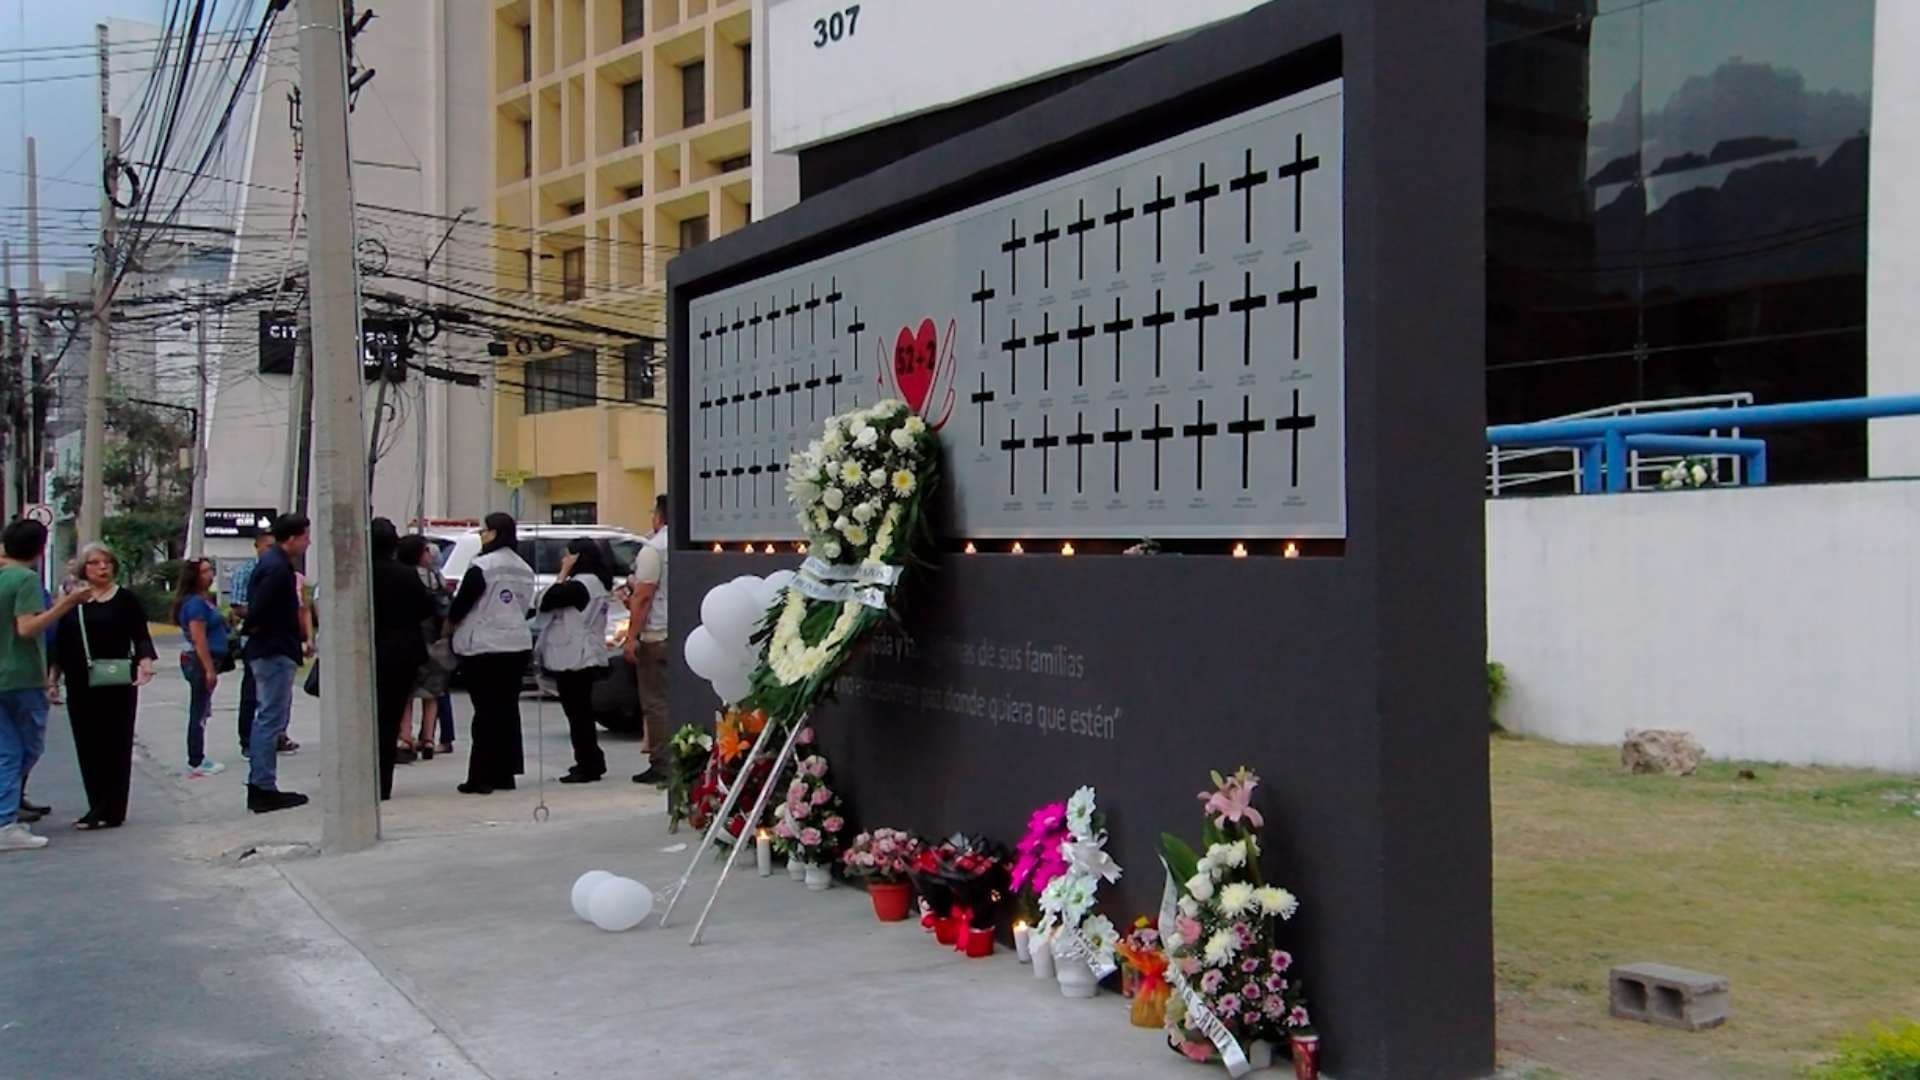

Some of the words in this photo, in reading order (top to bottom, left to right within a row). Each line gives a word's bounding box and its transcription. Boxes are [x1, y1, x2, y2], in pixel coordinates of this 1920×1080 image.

[813, 4, 861, 49] 307
[977, 637, 997, 668] de
[998, 646, 1023, 671] sus
[1024, 640, 1085, 679] familias
[943, 682, 986, 717] donde
[987, 690, 1033, 728] quiera
[1037, 703, 1067, 736] que
